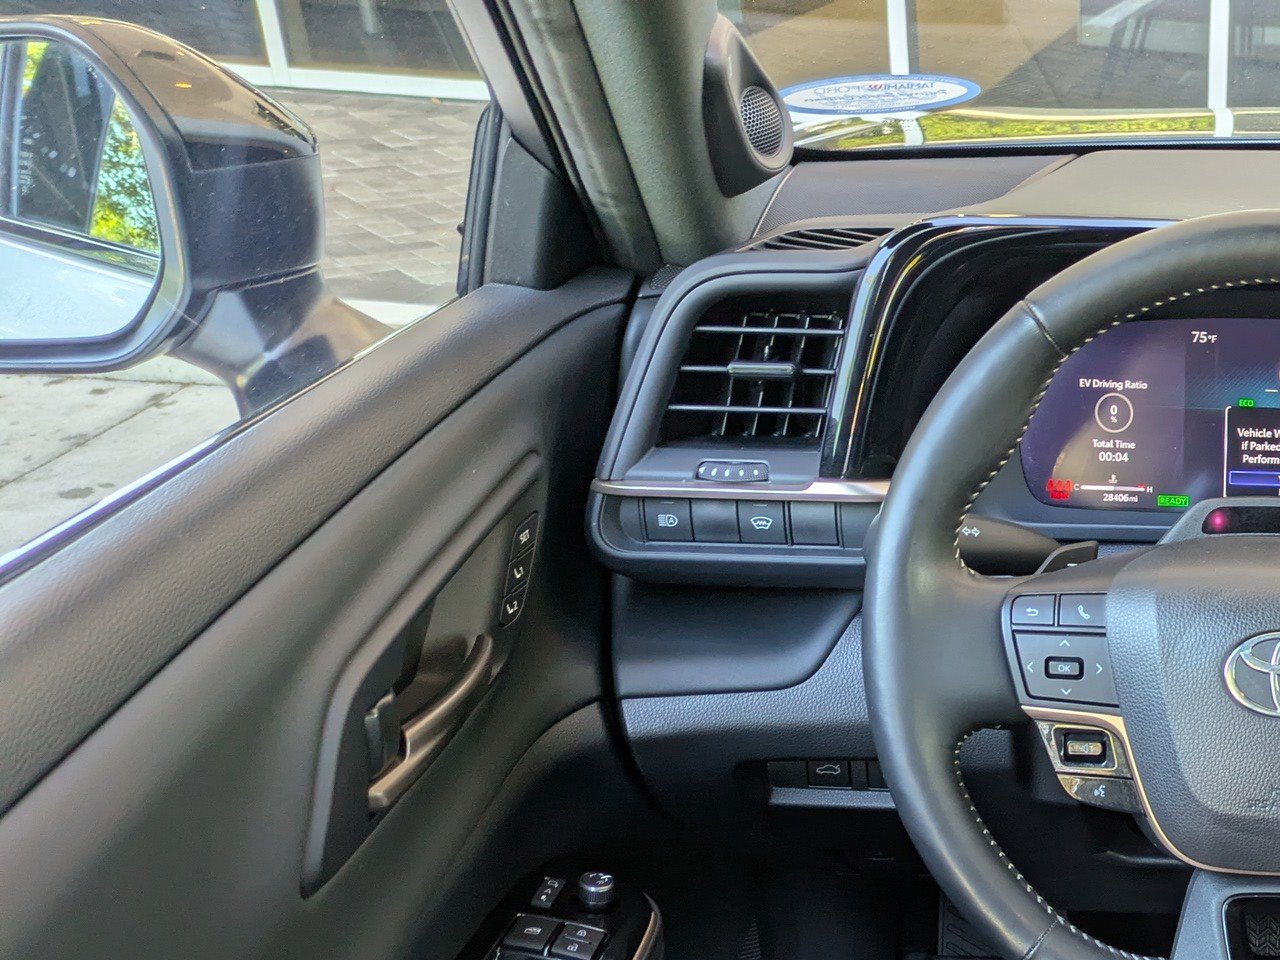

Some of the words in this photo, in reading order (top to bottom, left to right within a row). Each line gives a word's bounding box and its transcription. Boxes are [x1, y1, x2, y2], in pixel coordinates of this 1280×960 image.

[1079, 379, 1091, 388] EV
[1092, 379, 1124, 391] Driving
[1125, 380, 1148, 390] Ratio
[1238, 399, 1254, 407] ECO
[1110, 405, 1118, 415] 0
[1237, 428, 1272, 439] Vehicle
[1092, 439, 1114, 449] Total
[1115, 440, 1136, 449] Time
[1241, 441, 1248, 451] if
[1098, 451, 1129, 462] 00:04
[1242, 454, 1280, 464] Perform
[1159, 497, 1187, 505] READY
[519, 529, 530, 544] SET
[1058, 664, 1071, 673] OK
